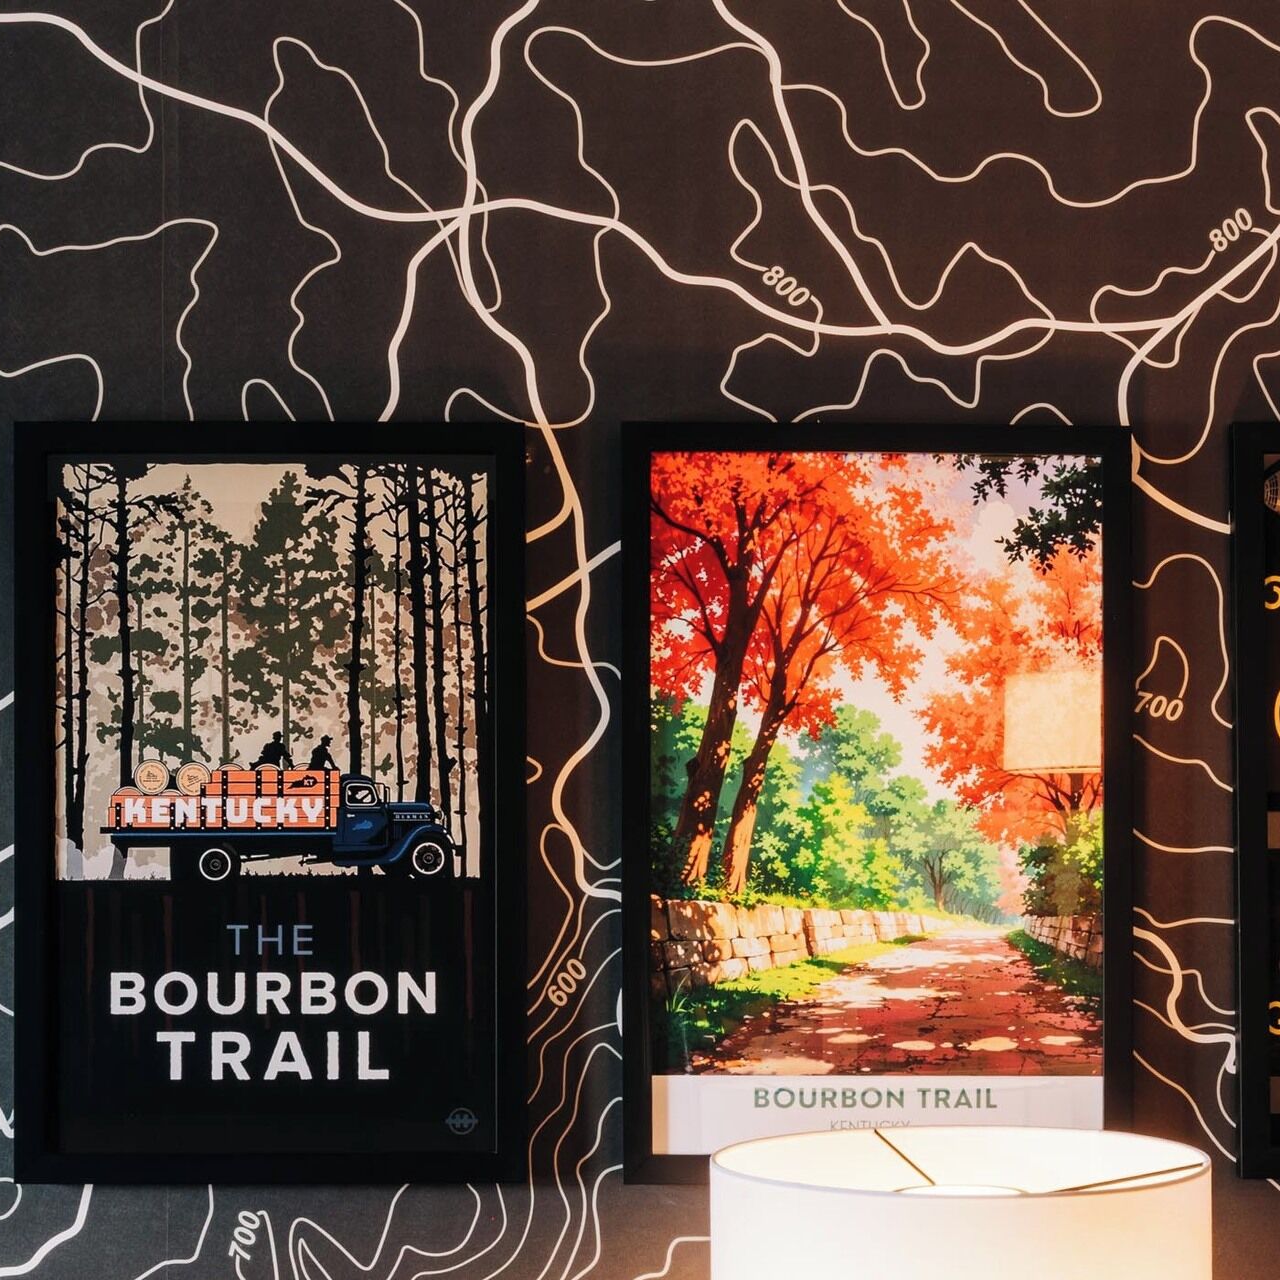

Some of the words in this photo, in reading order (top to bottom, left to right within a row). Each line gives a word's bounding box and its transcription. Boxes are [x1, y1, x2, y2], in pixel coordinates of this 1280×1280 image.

[1209, 207, 1253, 253] 800
[762, 265, 811, 306] 800
[1135, 690, 1184, 723] 700
[124, 797, 322, 825] KENTUCKY
[226, 924, 313, 956] THE
[110, 970, 436, 1016] BOURBON
[549, 957, 588, 1008] 600
[156, 1031, 390, 1081] TRAIL
[753, 1087, 905, 1109] BOURBON
[916, 1087, 998, 1109] TRAIL
[229, 1210, 261, 1262] 700
